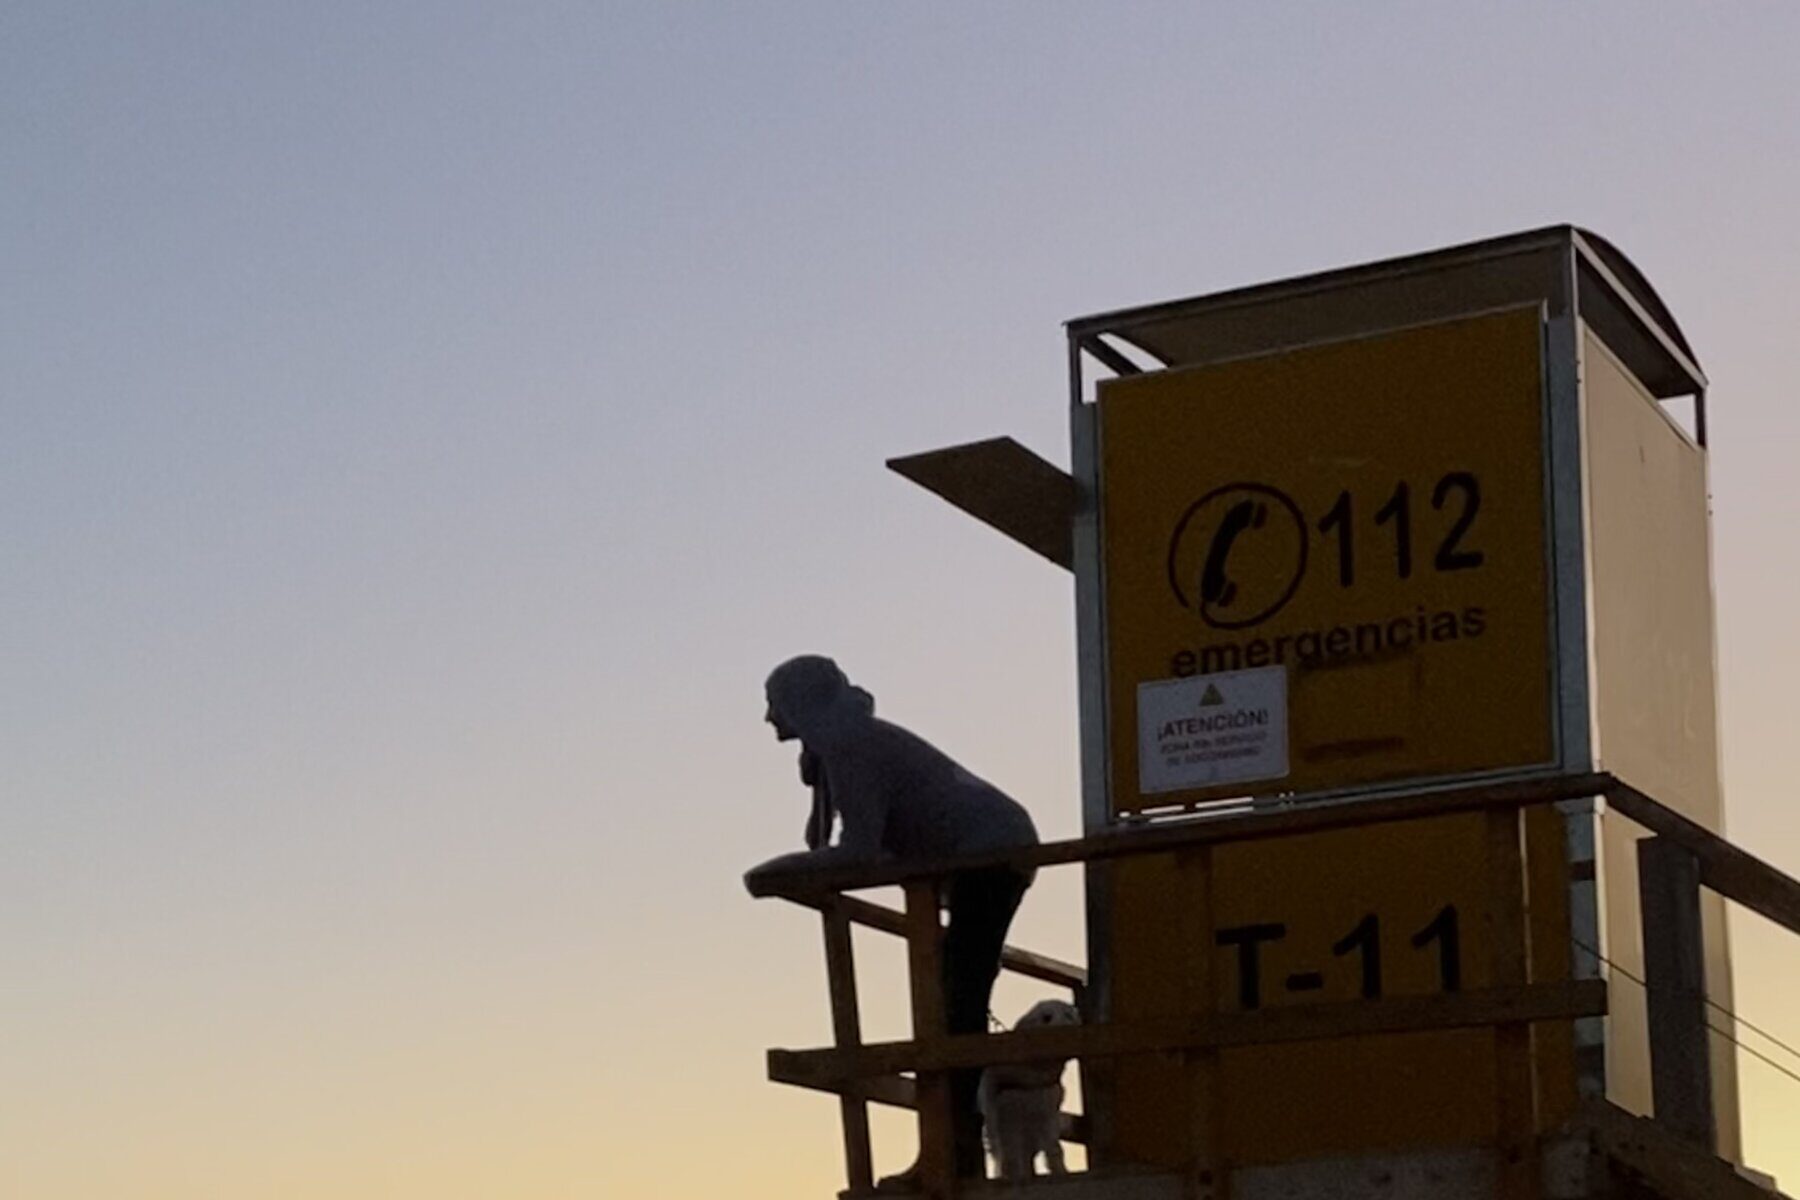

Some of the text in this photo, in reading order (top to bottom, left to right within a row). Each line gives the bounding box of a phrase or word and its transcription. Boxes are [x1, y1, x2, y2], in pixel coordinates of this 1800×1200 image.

[1318, 471, 1485, 588] 112
[1172, 605, 1488, 678] emergencias
[1215, 904, 1461, 1009] T-11
